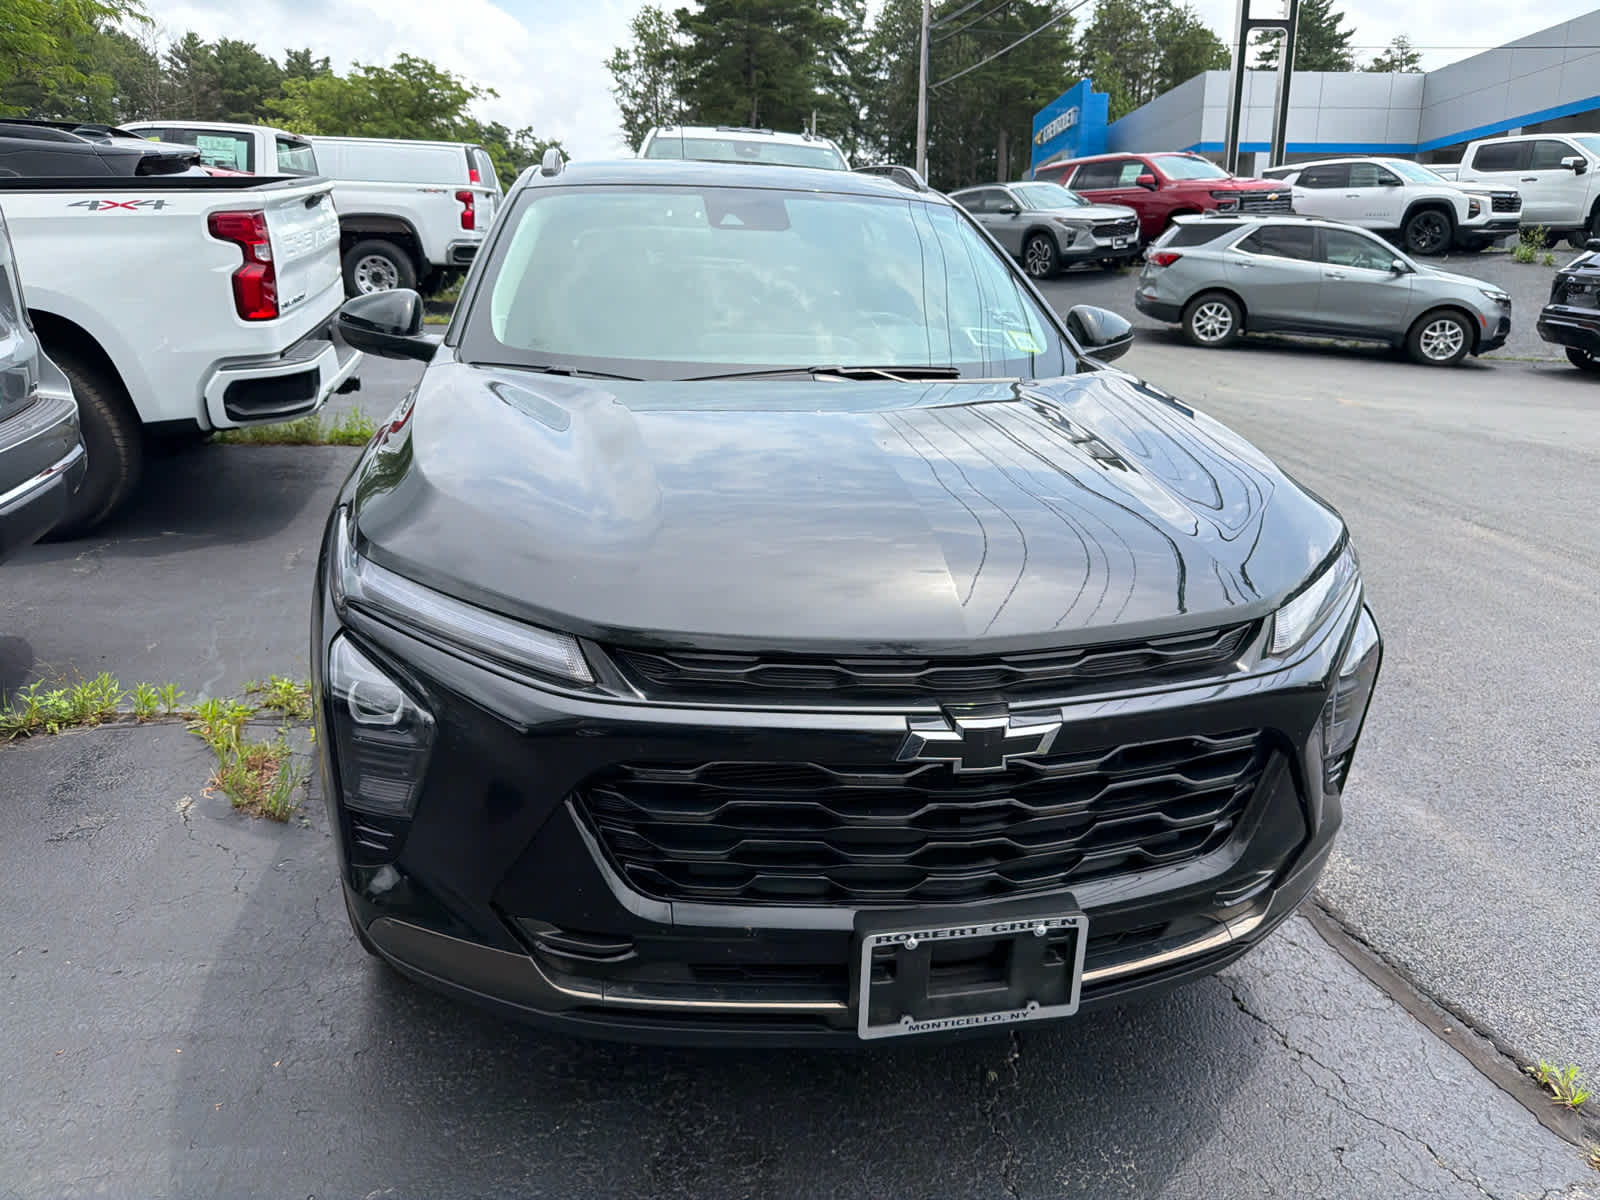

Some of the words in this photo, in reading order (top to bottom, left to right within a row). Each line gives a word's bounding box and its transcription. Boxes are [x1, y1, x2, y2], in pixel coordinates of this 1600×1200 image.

[875, 926, 983, 945] ROBERT
[991, 918, 1077, 933] GREEN
[908, 1014, 1006, 1032] MONTICELLO,
[1010, 1010, 1029, 1020] NY
